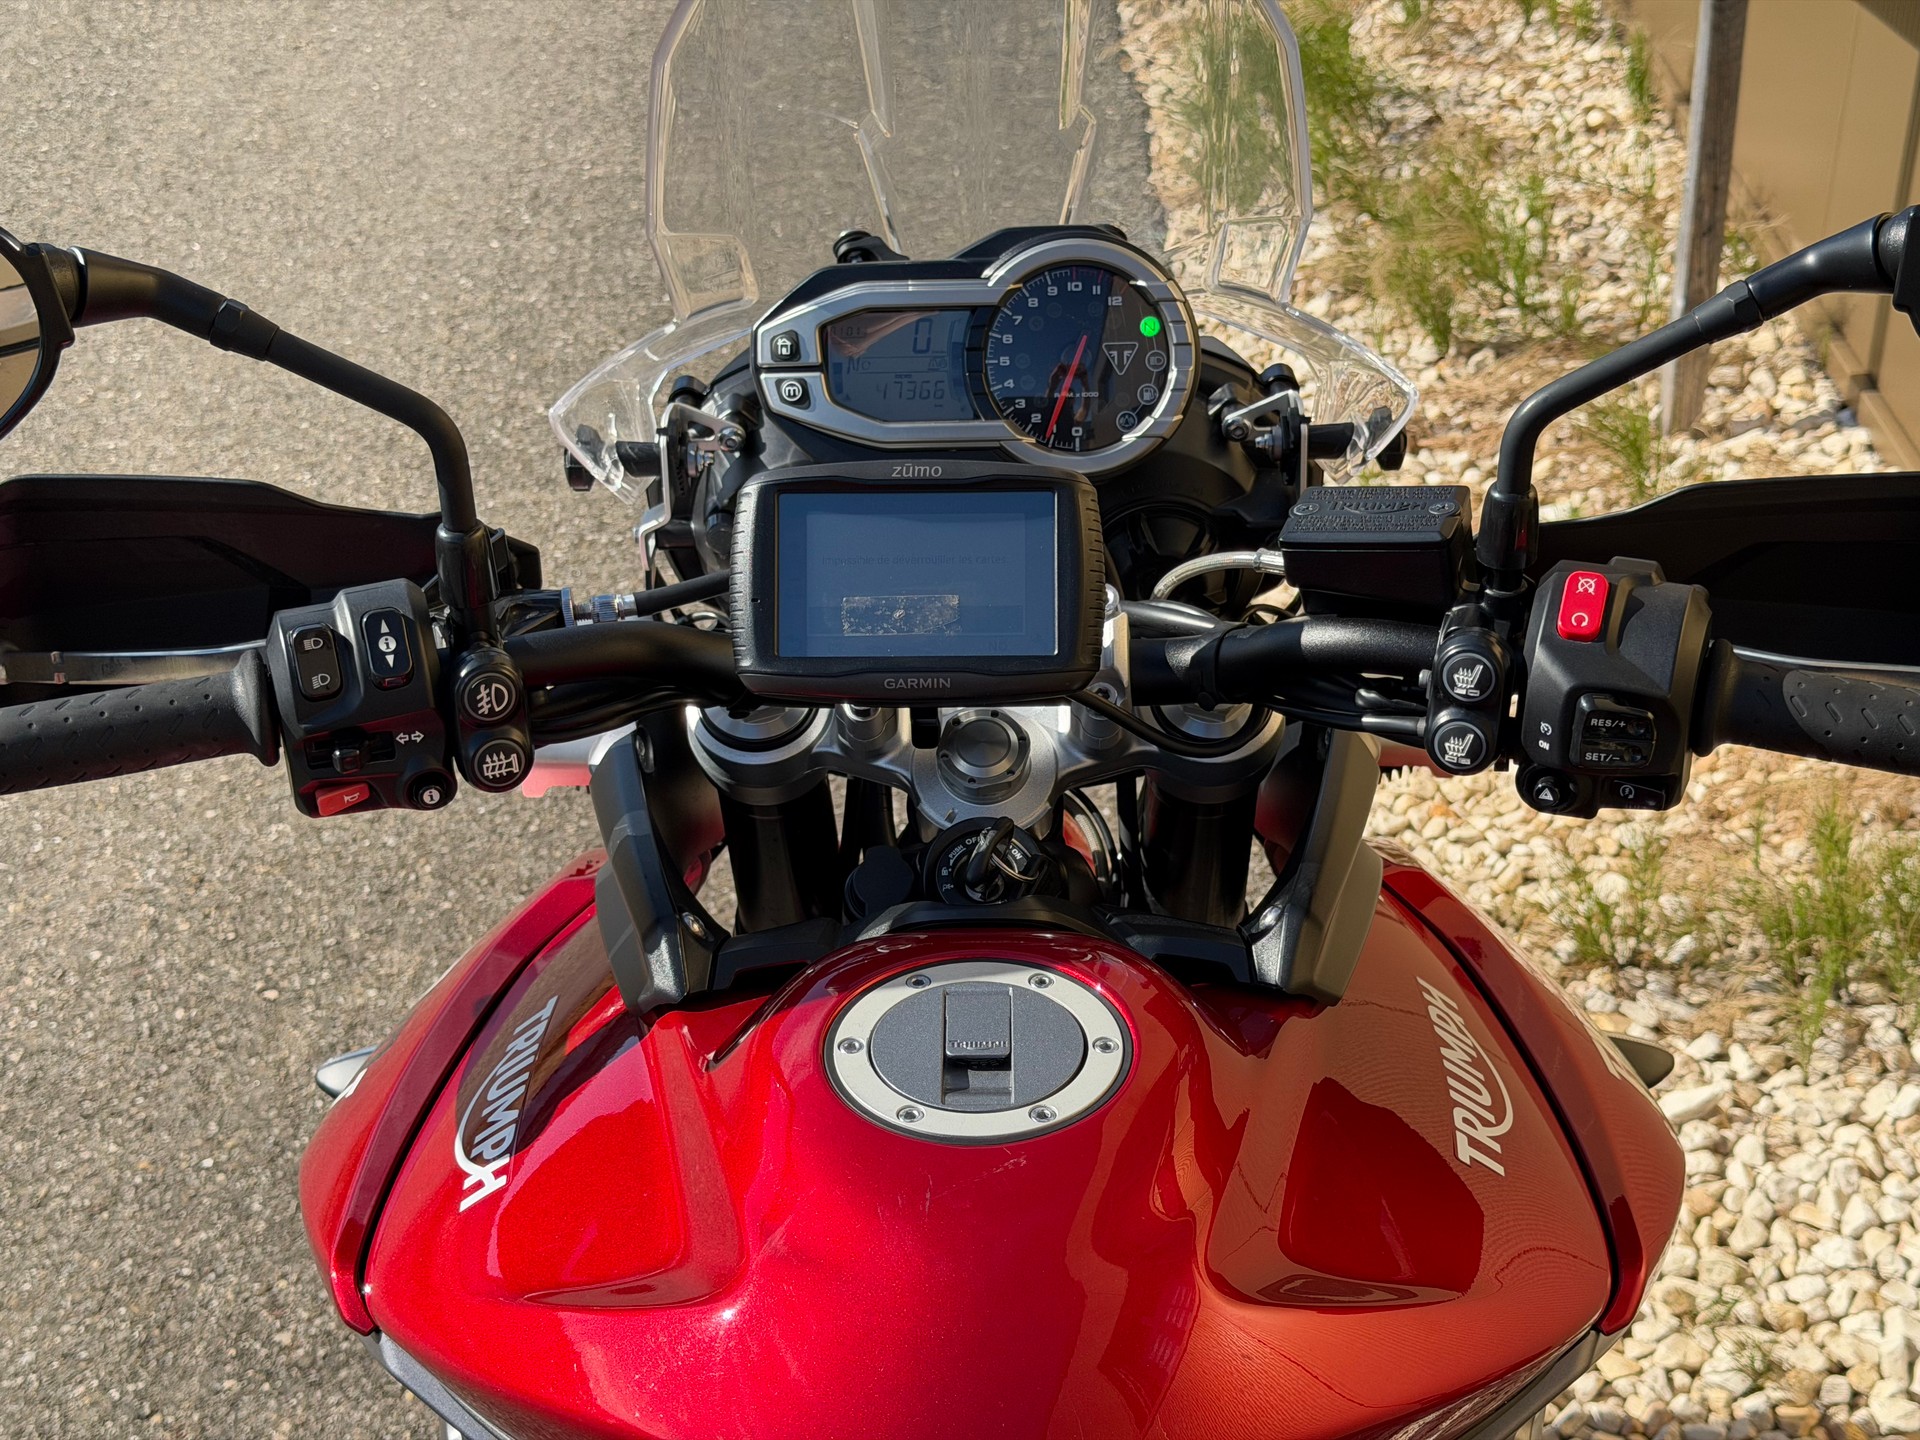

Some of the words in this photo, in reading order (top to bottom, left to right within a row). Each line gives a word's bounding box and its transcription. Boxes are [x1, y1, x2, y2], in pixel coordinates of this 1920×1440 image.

[1047, 285, 1058, 296] 9
[1067, 281, 1082, 292] 10
[1092, 285, 1101, 295] 11
[1028, 297, 1039, 308] 8
[1107, 296, 1122, 306] 12
[1012, 315, 1023, 325] 7
[1144, 321, 1157, 332] N
[914, 318, 933, 353] 0
[1002, 334, 1013, 344] 6
[999, 356, 1010, 366] 5
[1004, 379, 1015, 388] 4
[876, 380, 945, 400] 47366
[1015, 399, 1026, 409] 3
[1031, 413, 1041, 423] 2
[1071, 427, 1083, 437] 0
[891, 463, 942, 478] zūmo
[1326, 501, 1428, 514] TRIUMPH
[877, 555, 890, 565] de
[883, 677, 952, 690] GARMIN
[1590, 718, 1626, 728] RES/+
[1539, 740, 1550, 751] ON
[948, 845, 964, 859] PUSH
[1012, 849, 1023, 860] ON
[949, 1040, 1009, 1050] TRIUMPH
[1416, 976, 1514, 1176] TRIUMPH
[454, 995, 559, 1212] TRIUMPH
